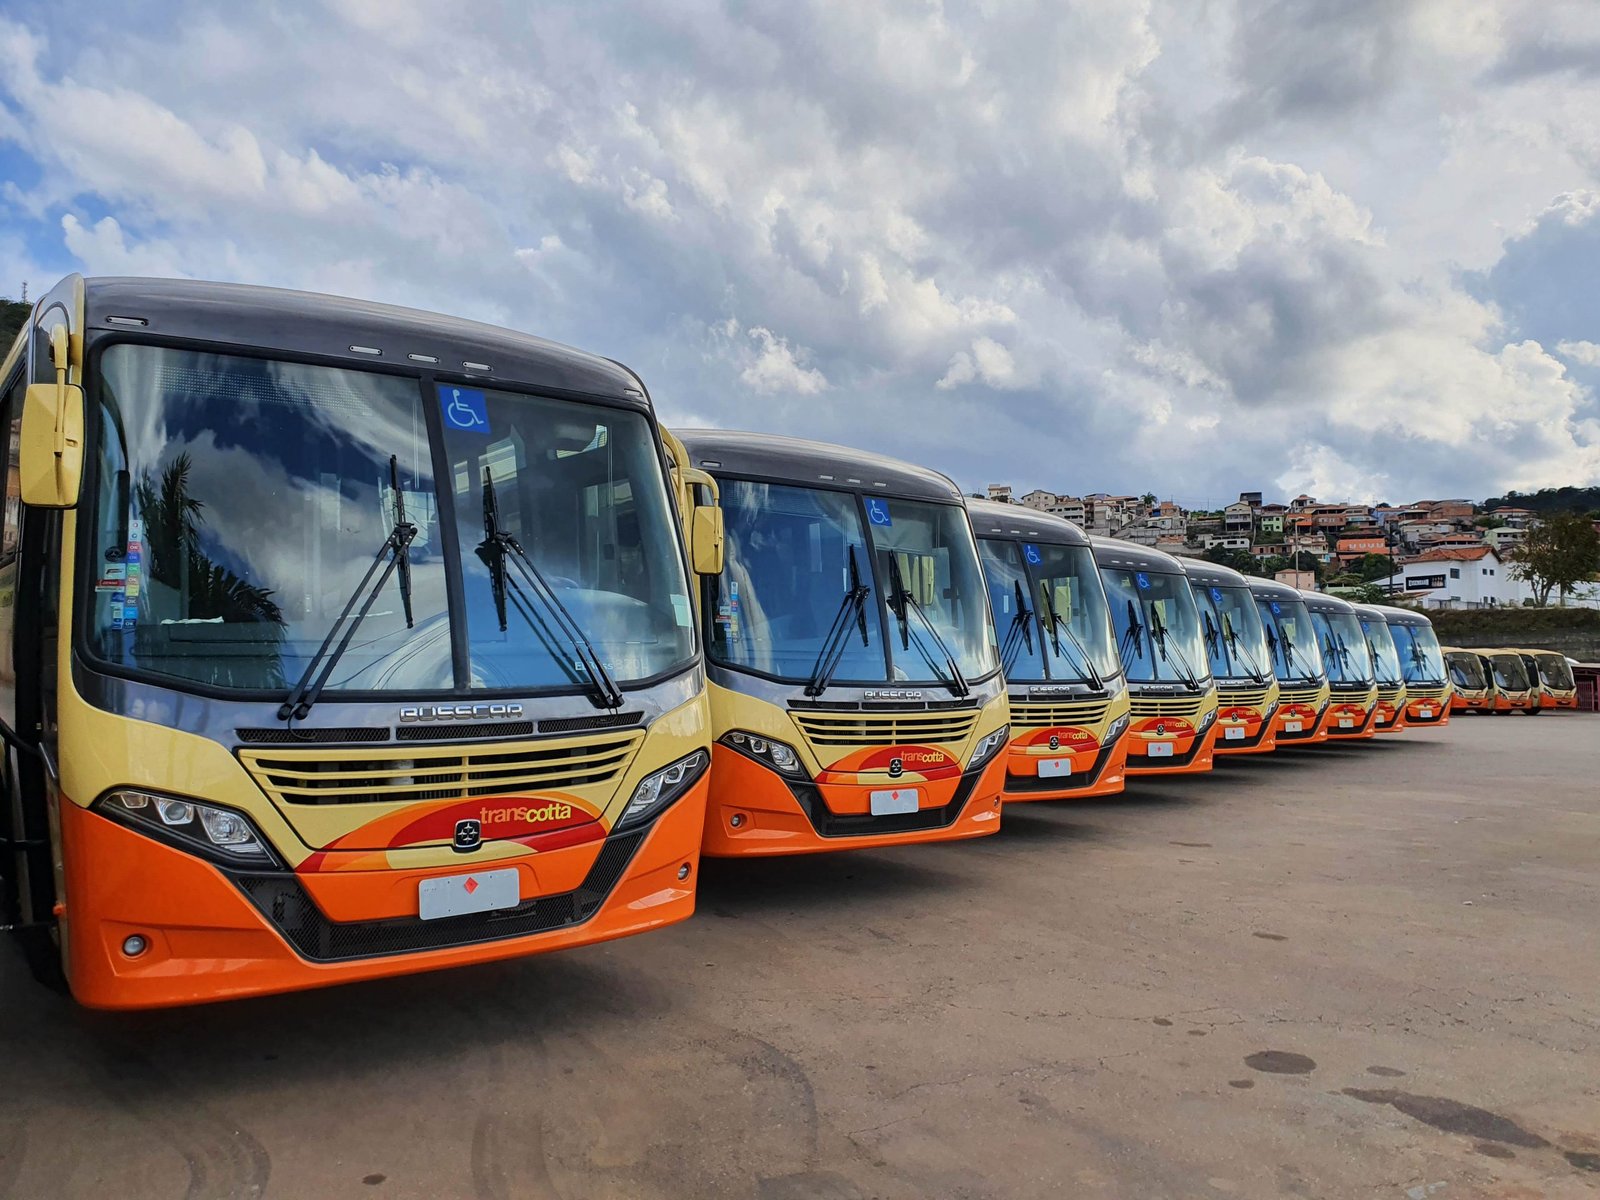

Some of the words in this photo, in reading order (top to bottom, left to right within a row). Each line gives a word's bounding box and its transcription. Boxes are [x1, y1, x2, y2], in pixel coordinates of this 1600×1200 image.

[400, 703, 523, 722] BUSSCAR
[901, 750, 944, 763] transcotta
[480, 803, 572, 824] transcotta
